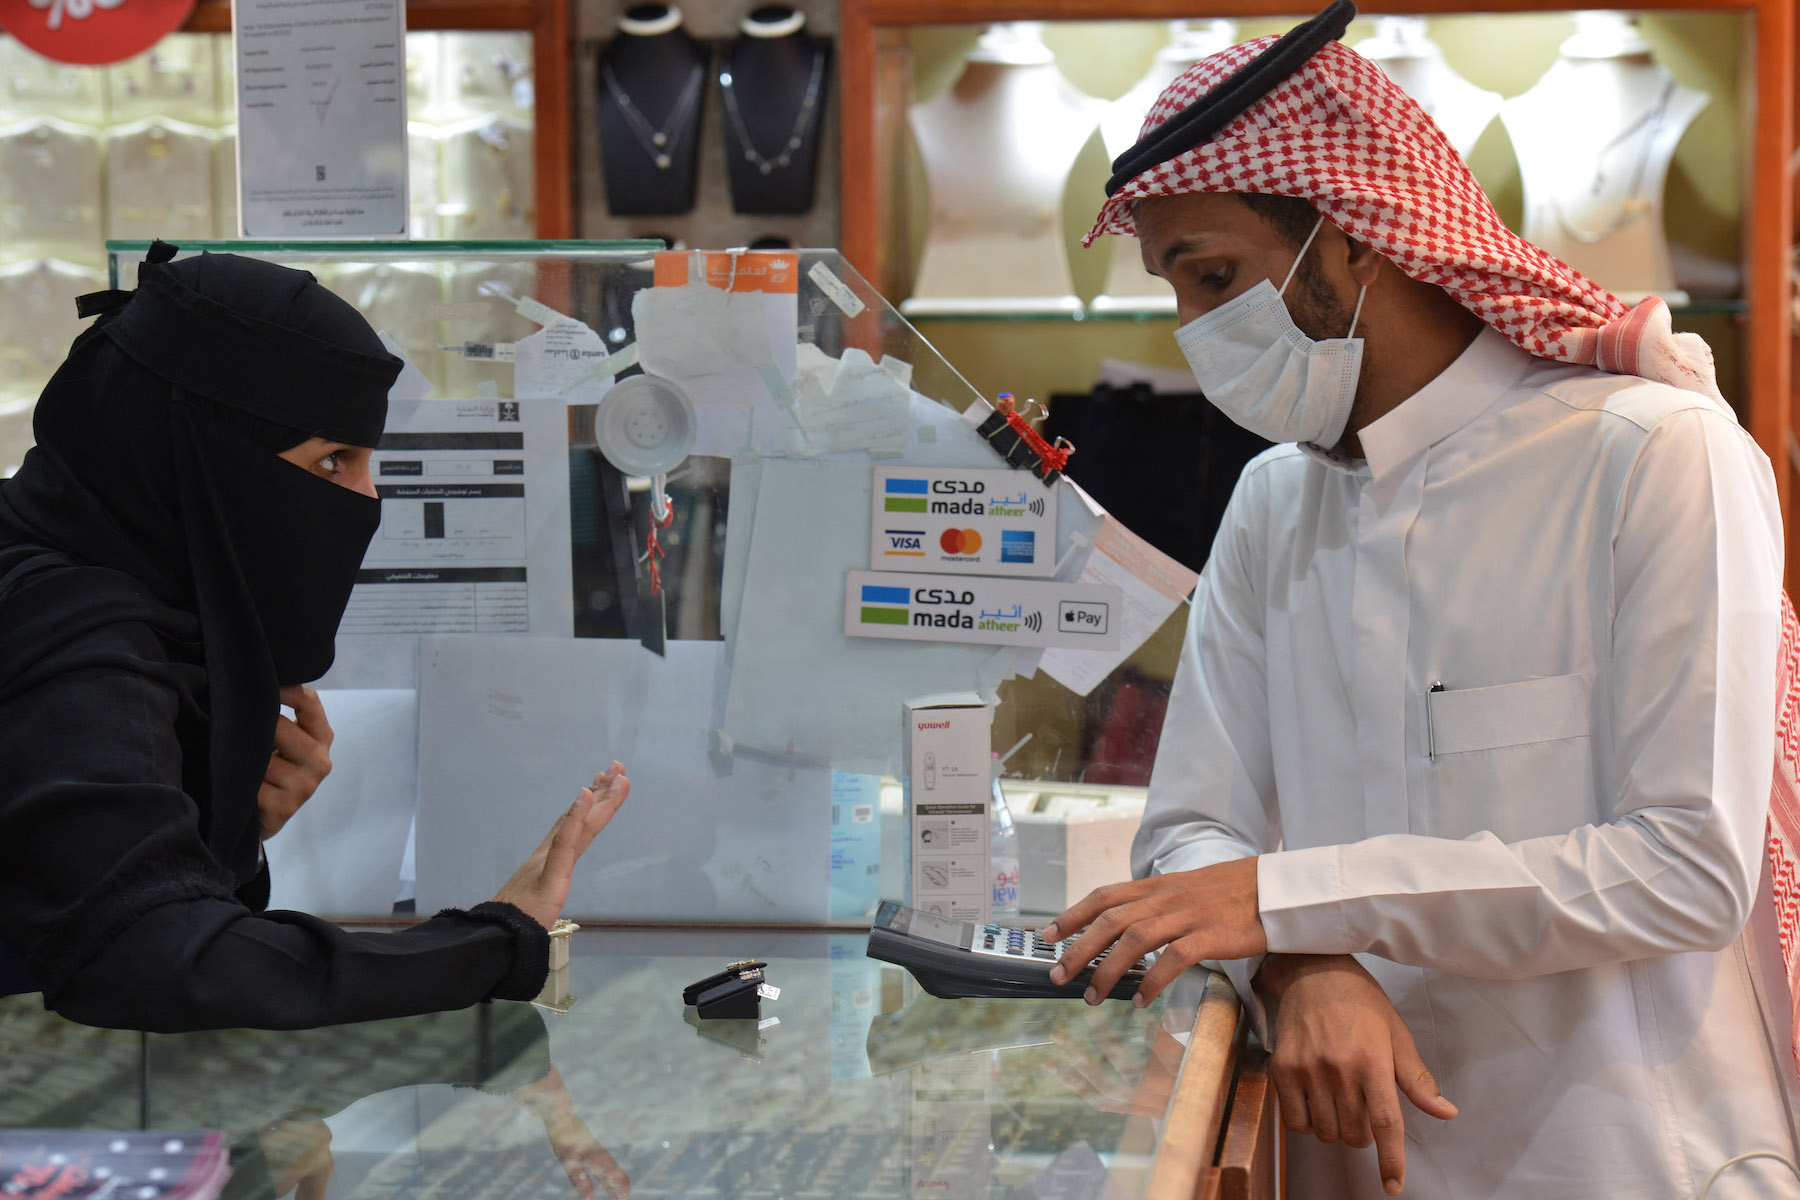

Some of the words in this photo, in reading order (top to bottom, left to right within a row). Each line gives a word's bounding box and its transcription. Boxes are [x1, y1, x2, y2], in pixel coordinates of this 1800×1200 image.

[932, 480, 985, 494] مدى
[931, 498, 984, 515] mada
[988, 505, 1026, 517] atheer
[890, 537, 921, 549] VISA
[915, 588, 975, 605] مدى
[913, 609, 974, 629] mada
[978, 618, 1021, 632] atheer
[1077, 611, 1102, 627] Pay
[917, 720, 951, 731] yuwell
